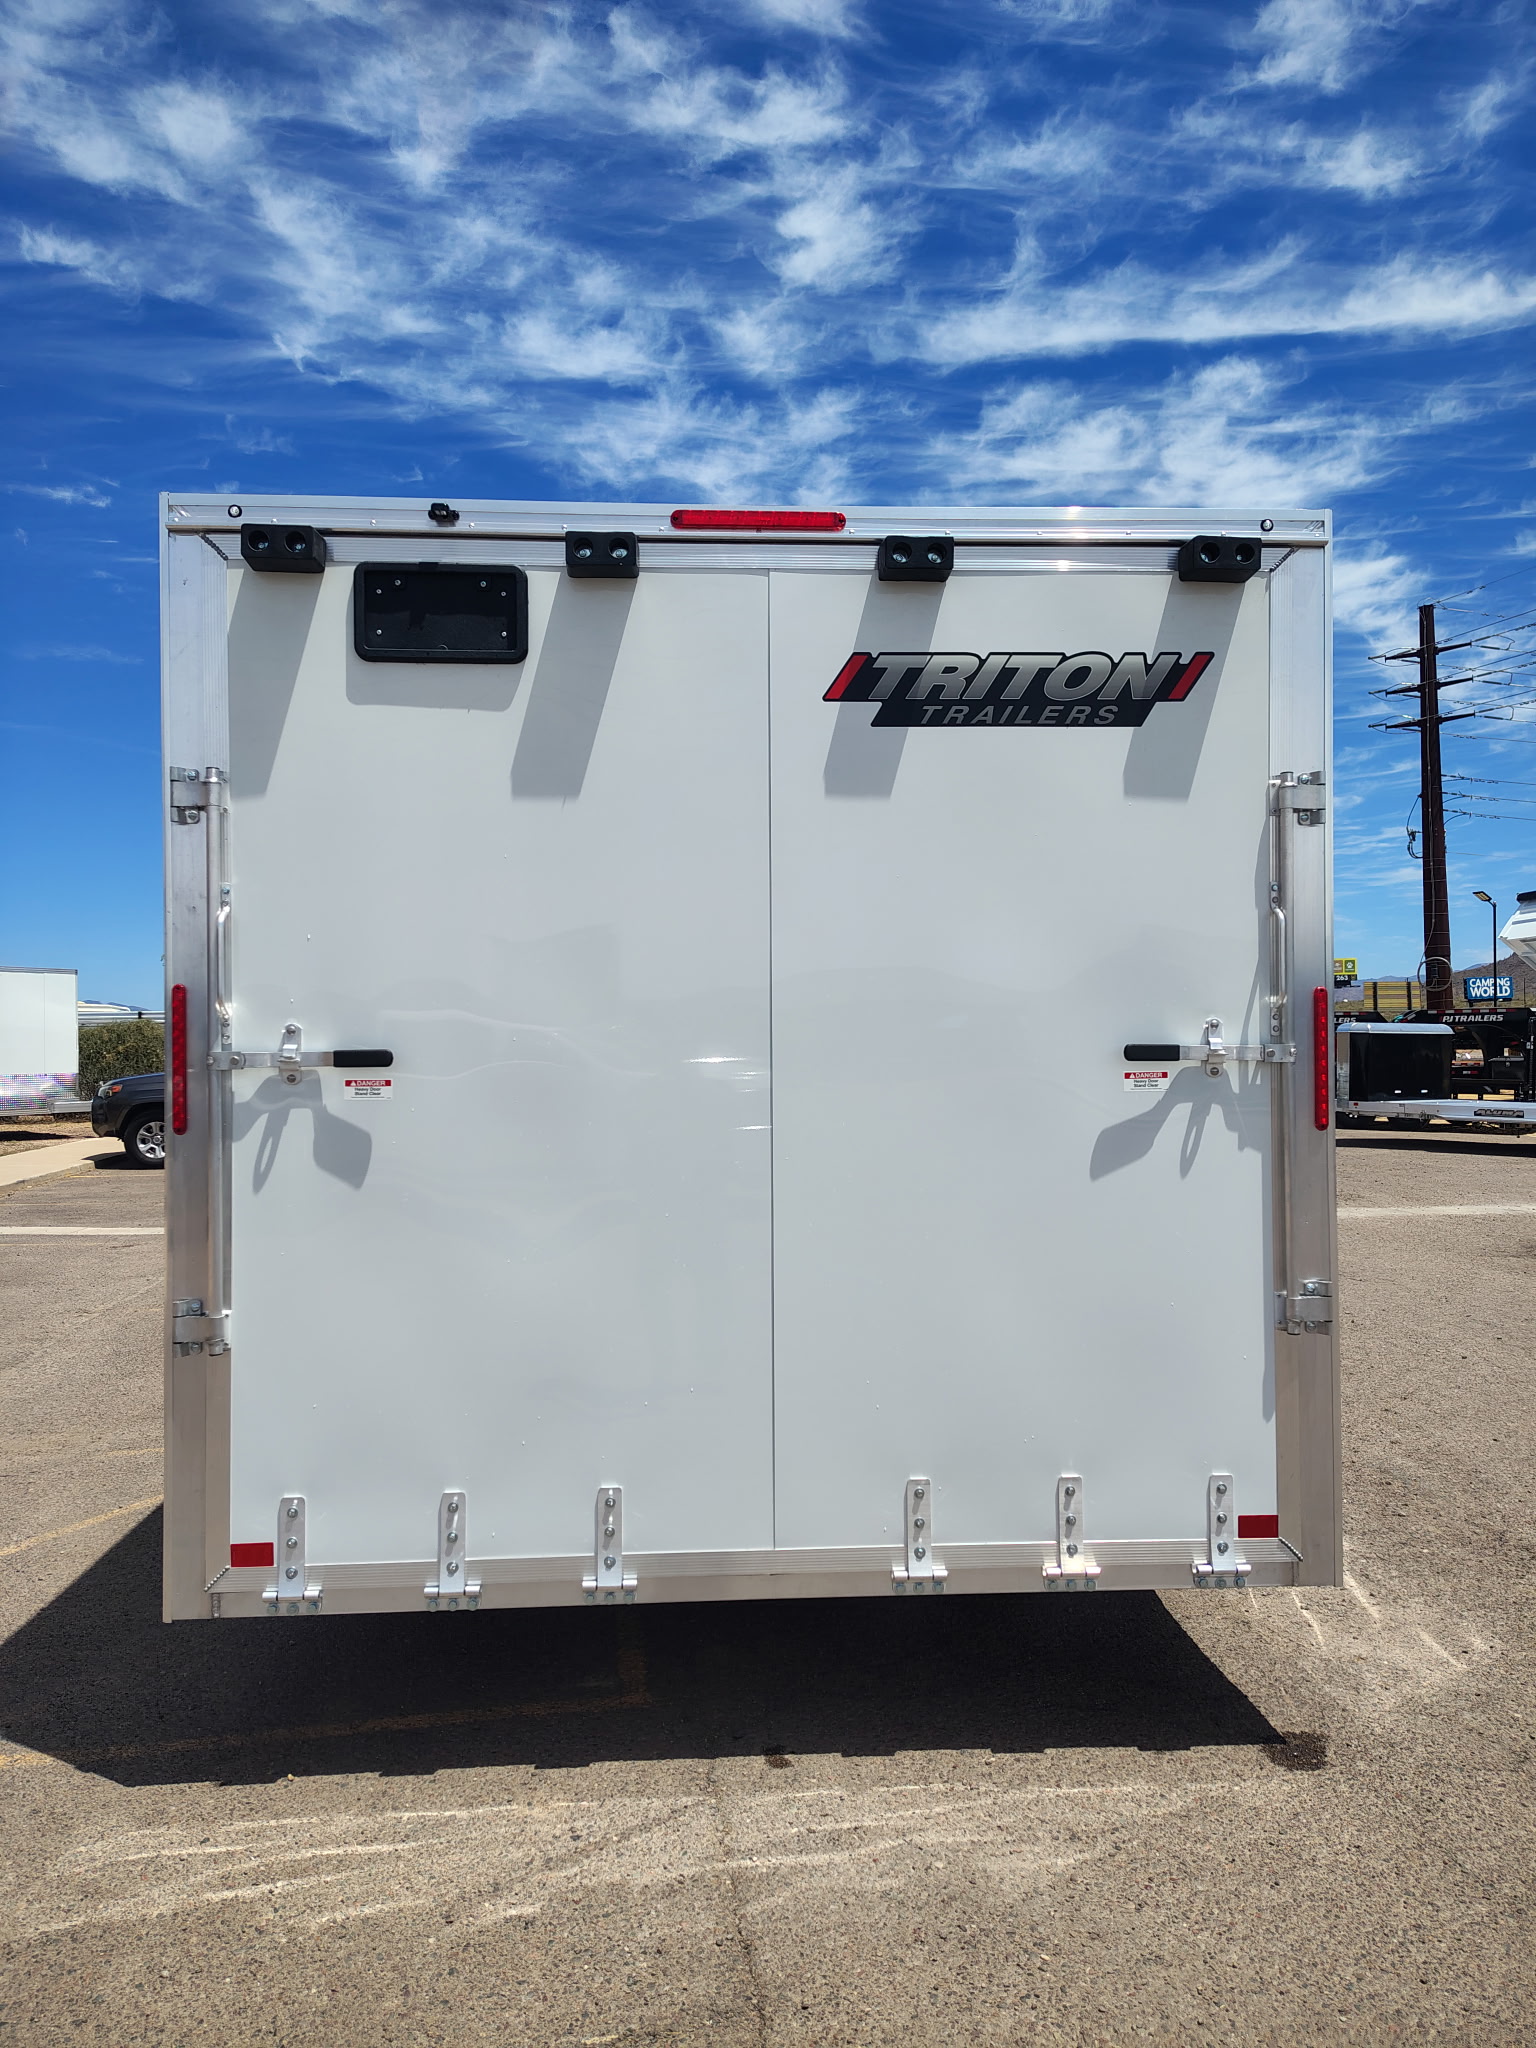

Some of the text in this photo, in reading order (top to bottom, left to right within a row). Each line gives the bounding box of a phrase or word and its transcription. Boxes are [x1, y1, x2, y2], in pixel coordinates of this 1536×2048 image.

[868, 653, 1180, 700] TRITON
[920, 705, 1119, 725] TRAILERS
[1469, 977, 1510, 987] CAMPNG
[1454, 1014, 1504, 1022] TRAILERS
